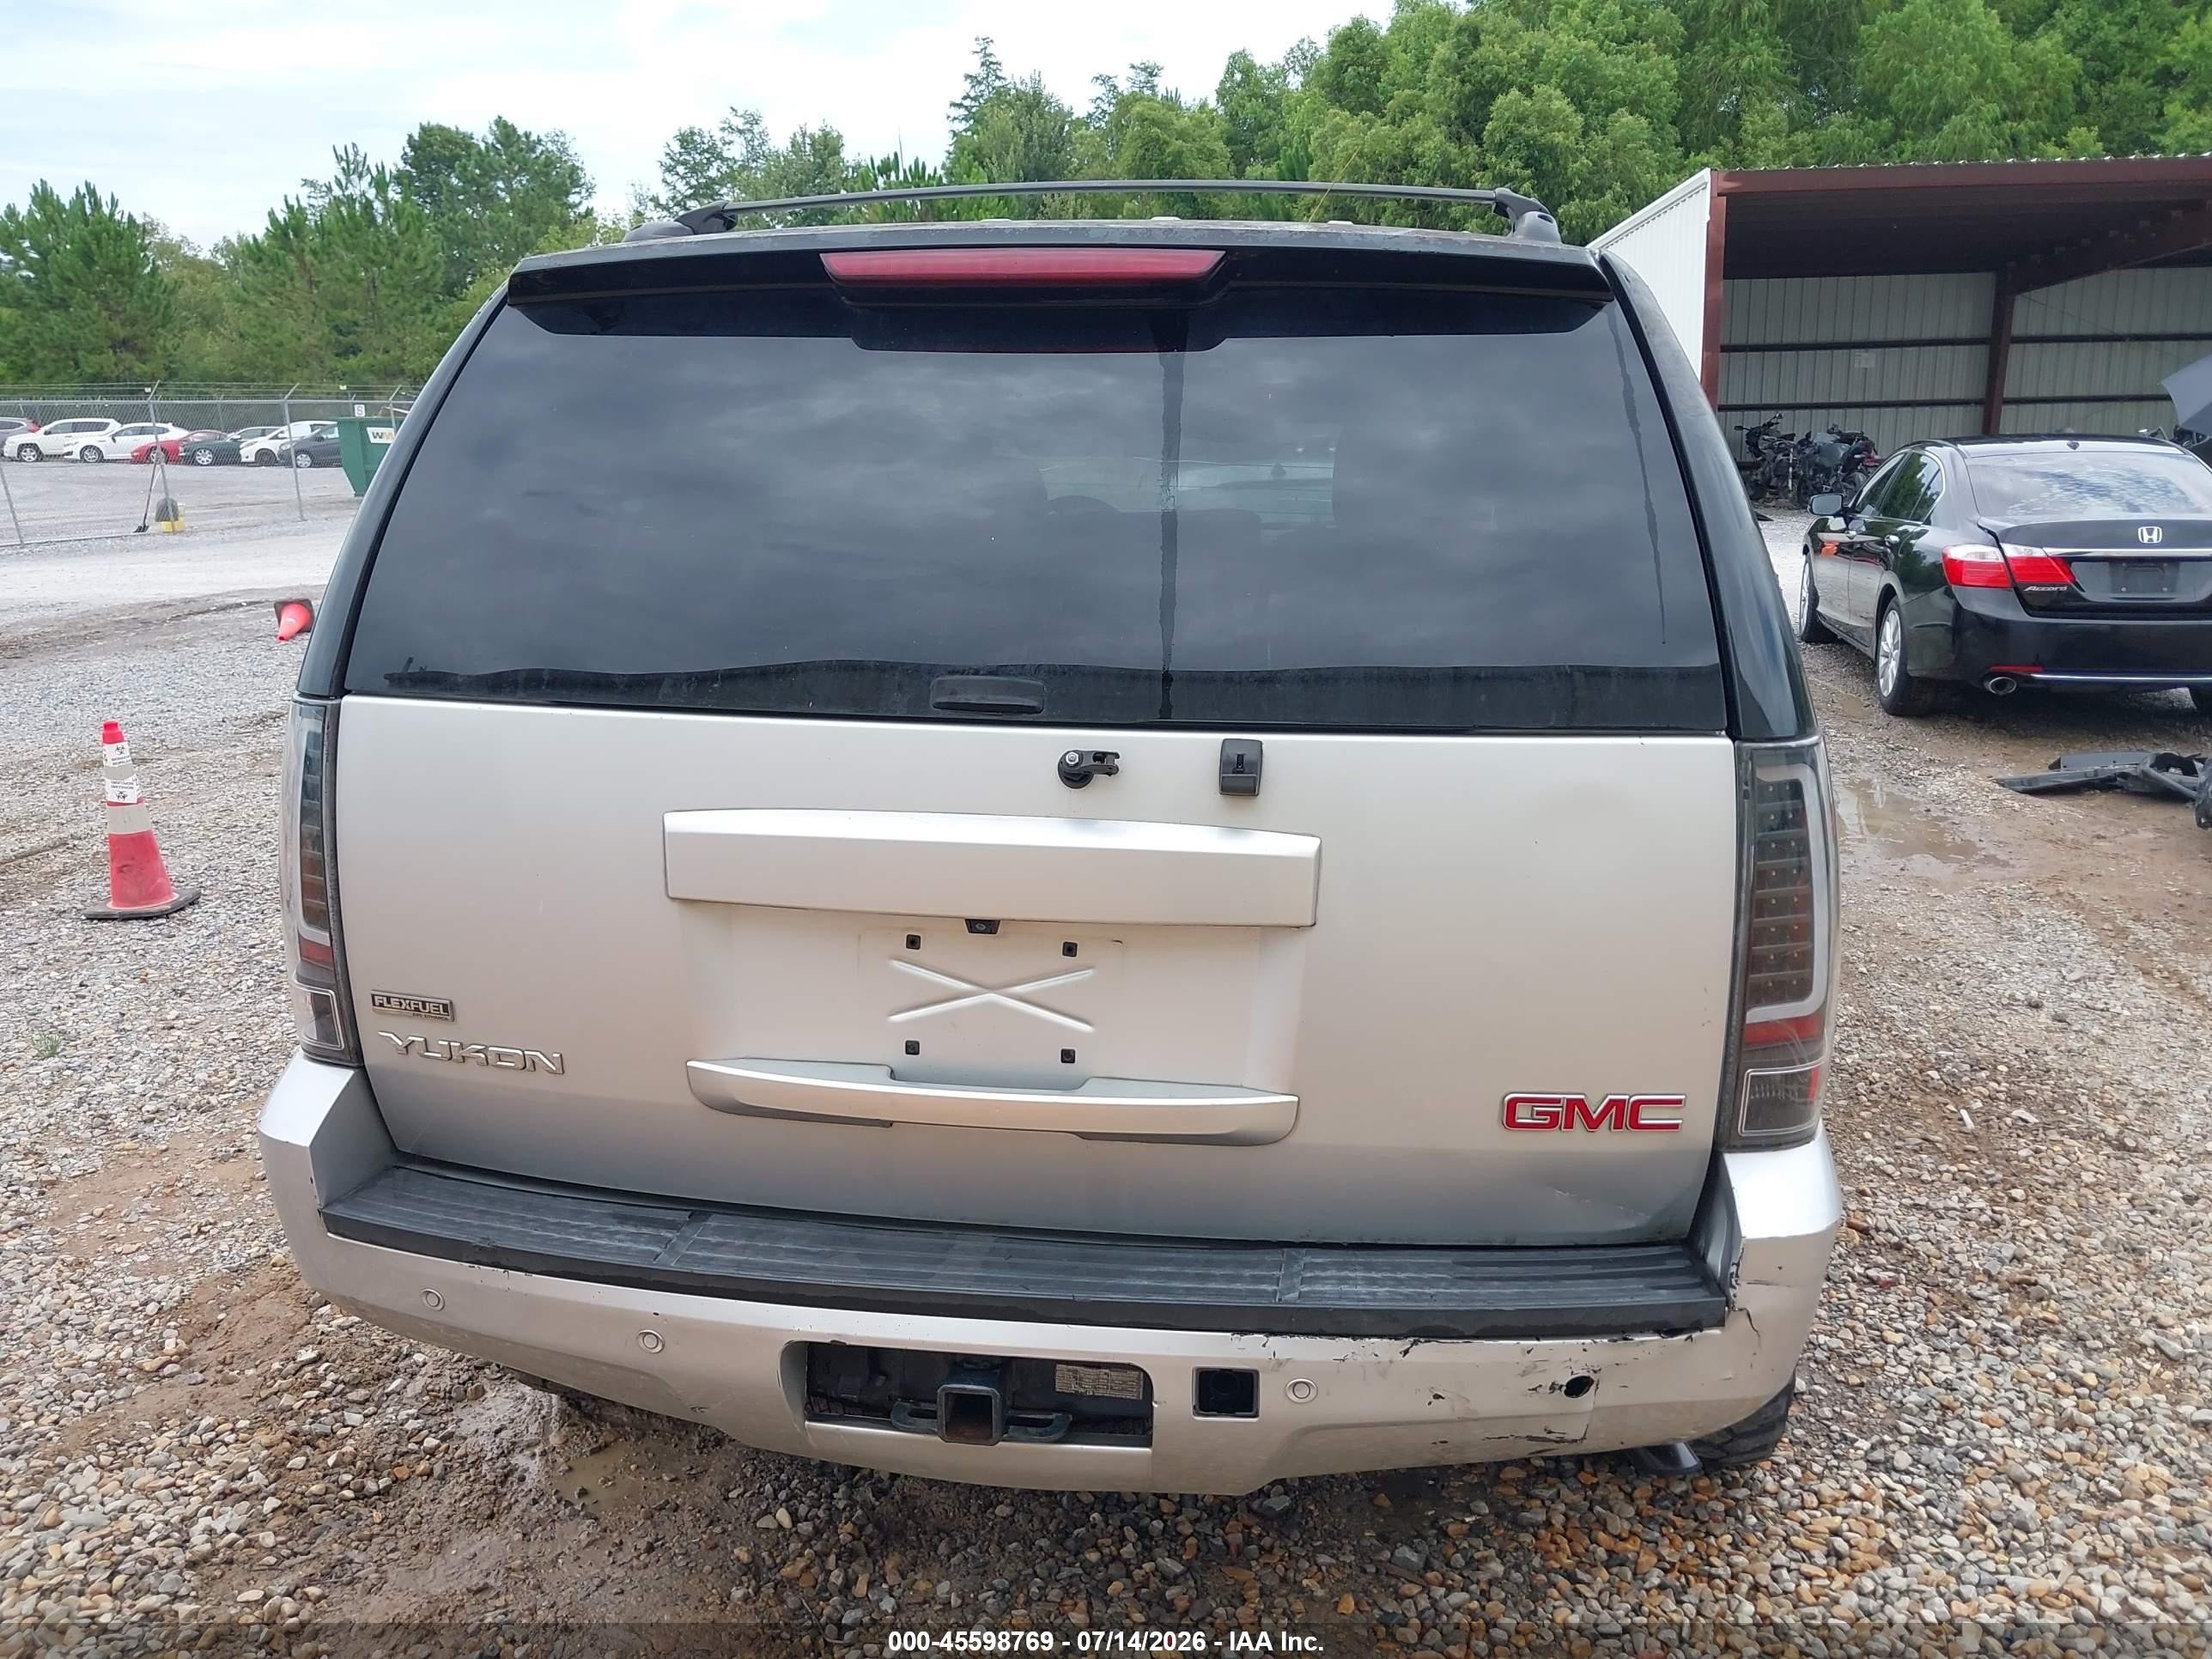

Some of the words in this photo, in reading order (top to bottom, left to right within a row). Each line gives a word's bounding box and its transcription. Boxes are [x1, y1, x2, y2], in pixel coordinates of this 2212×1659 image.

[374, 995, 448, 1015] FLEXFUEL
[378, 1030, 565, 1075] YUKON
[1503, 1092, 1686, 1133] GMC
